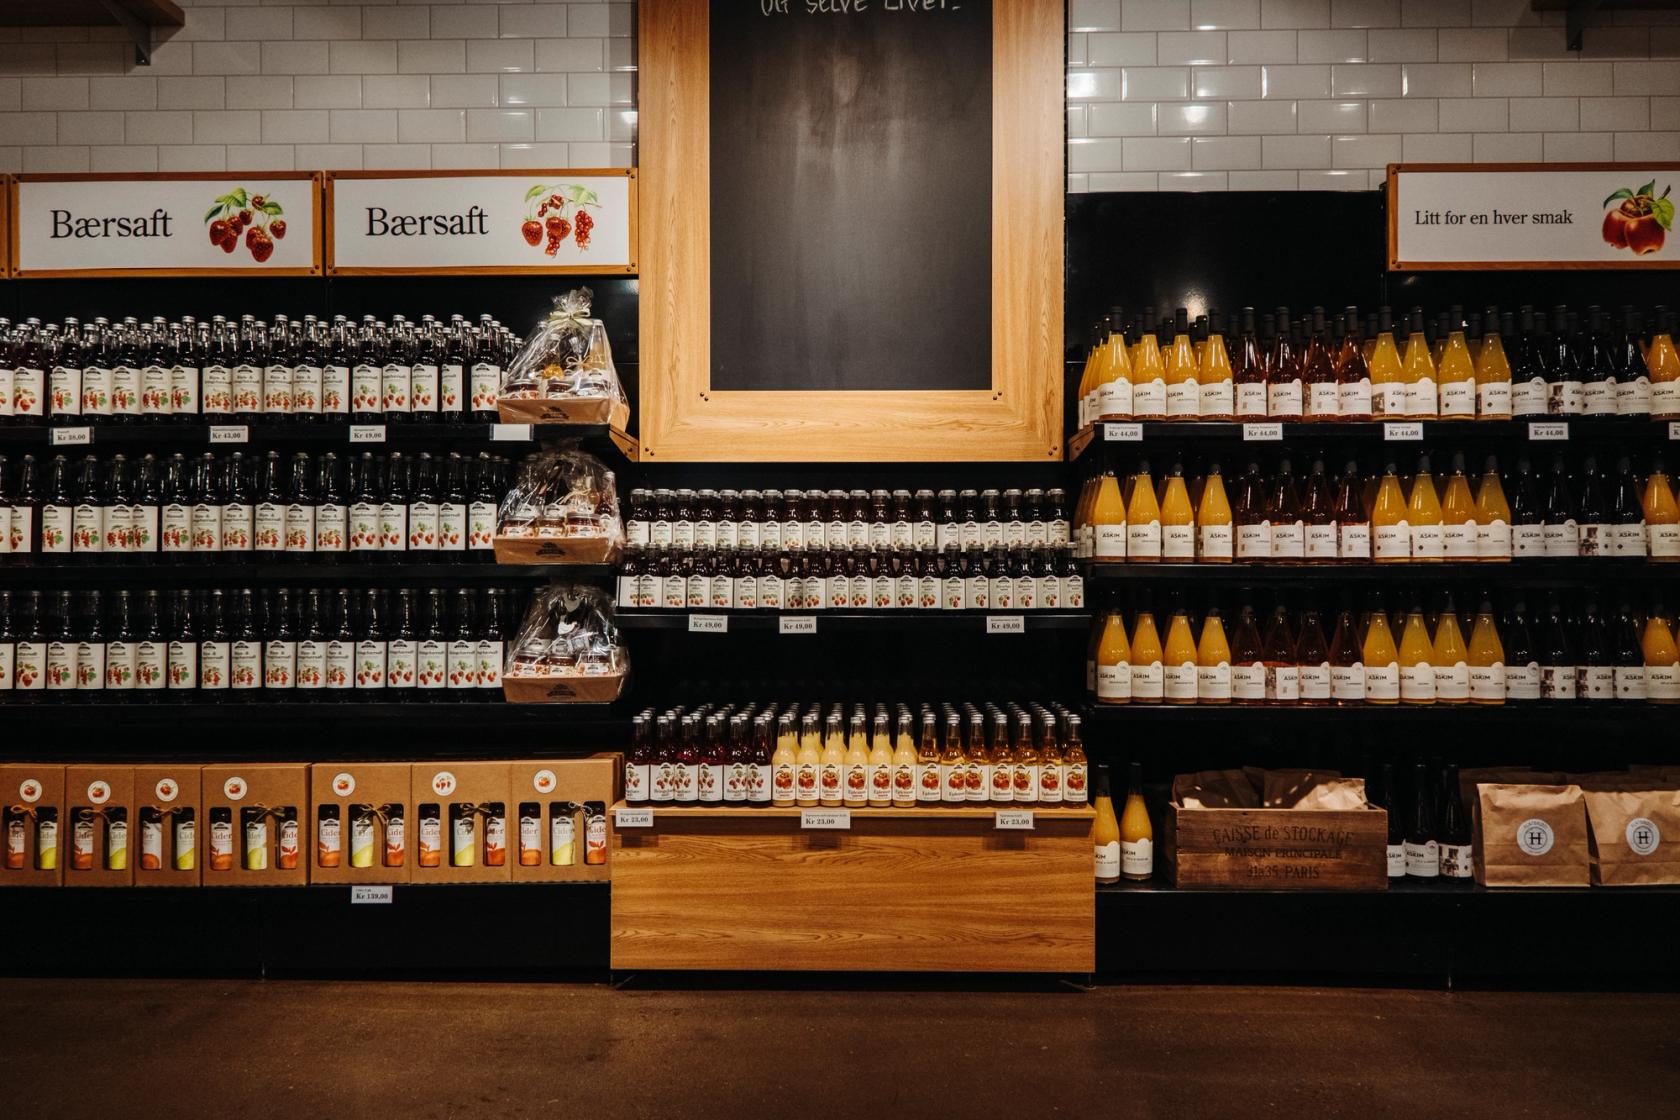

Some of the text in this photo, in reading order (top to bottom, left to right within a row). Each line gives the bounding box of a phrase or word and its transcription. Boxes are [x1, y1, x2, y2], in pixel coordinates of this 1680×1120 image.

[50, 208, 173, 239] Bærsaft
[365, 206, 489, 237] Bærsaft
[1414, 209, 1573, 225] Litt for en hver smak
[1264, 825, 1278, 840] de
[1530, 832, 1542, 845] H
[1638, 832, 1649, 844] H
[1285, 865, 1320, 879] PARIS
